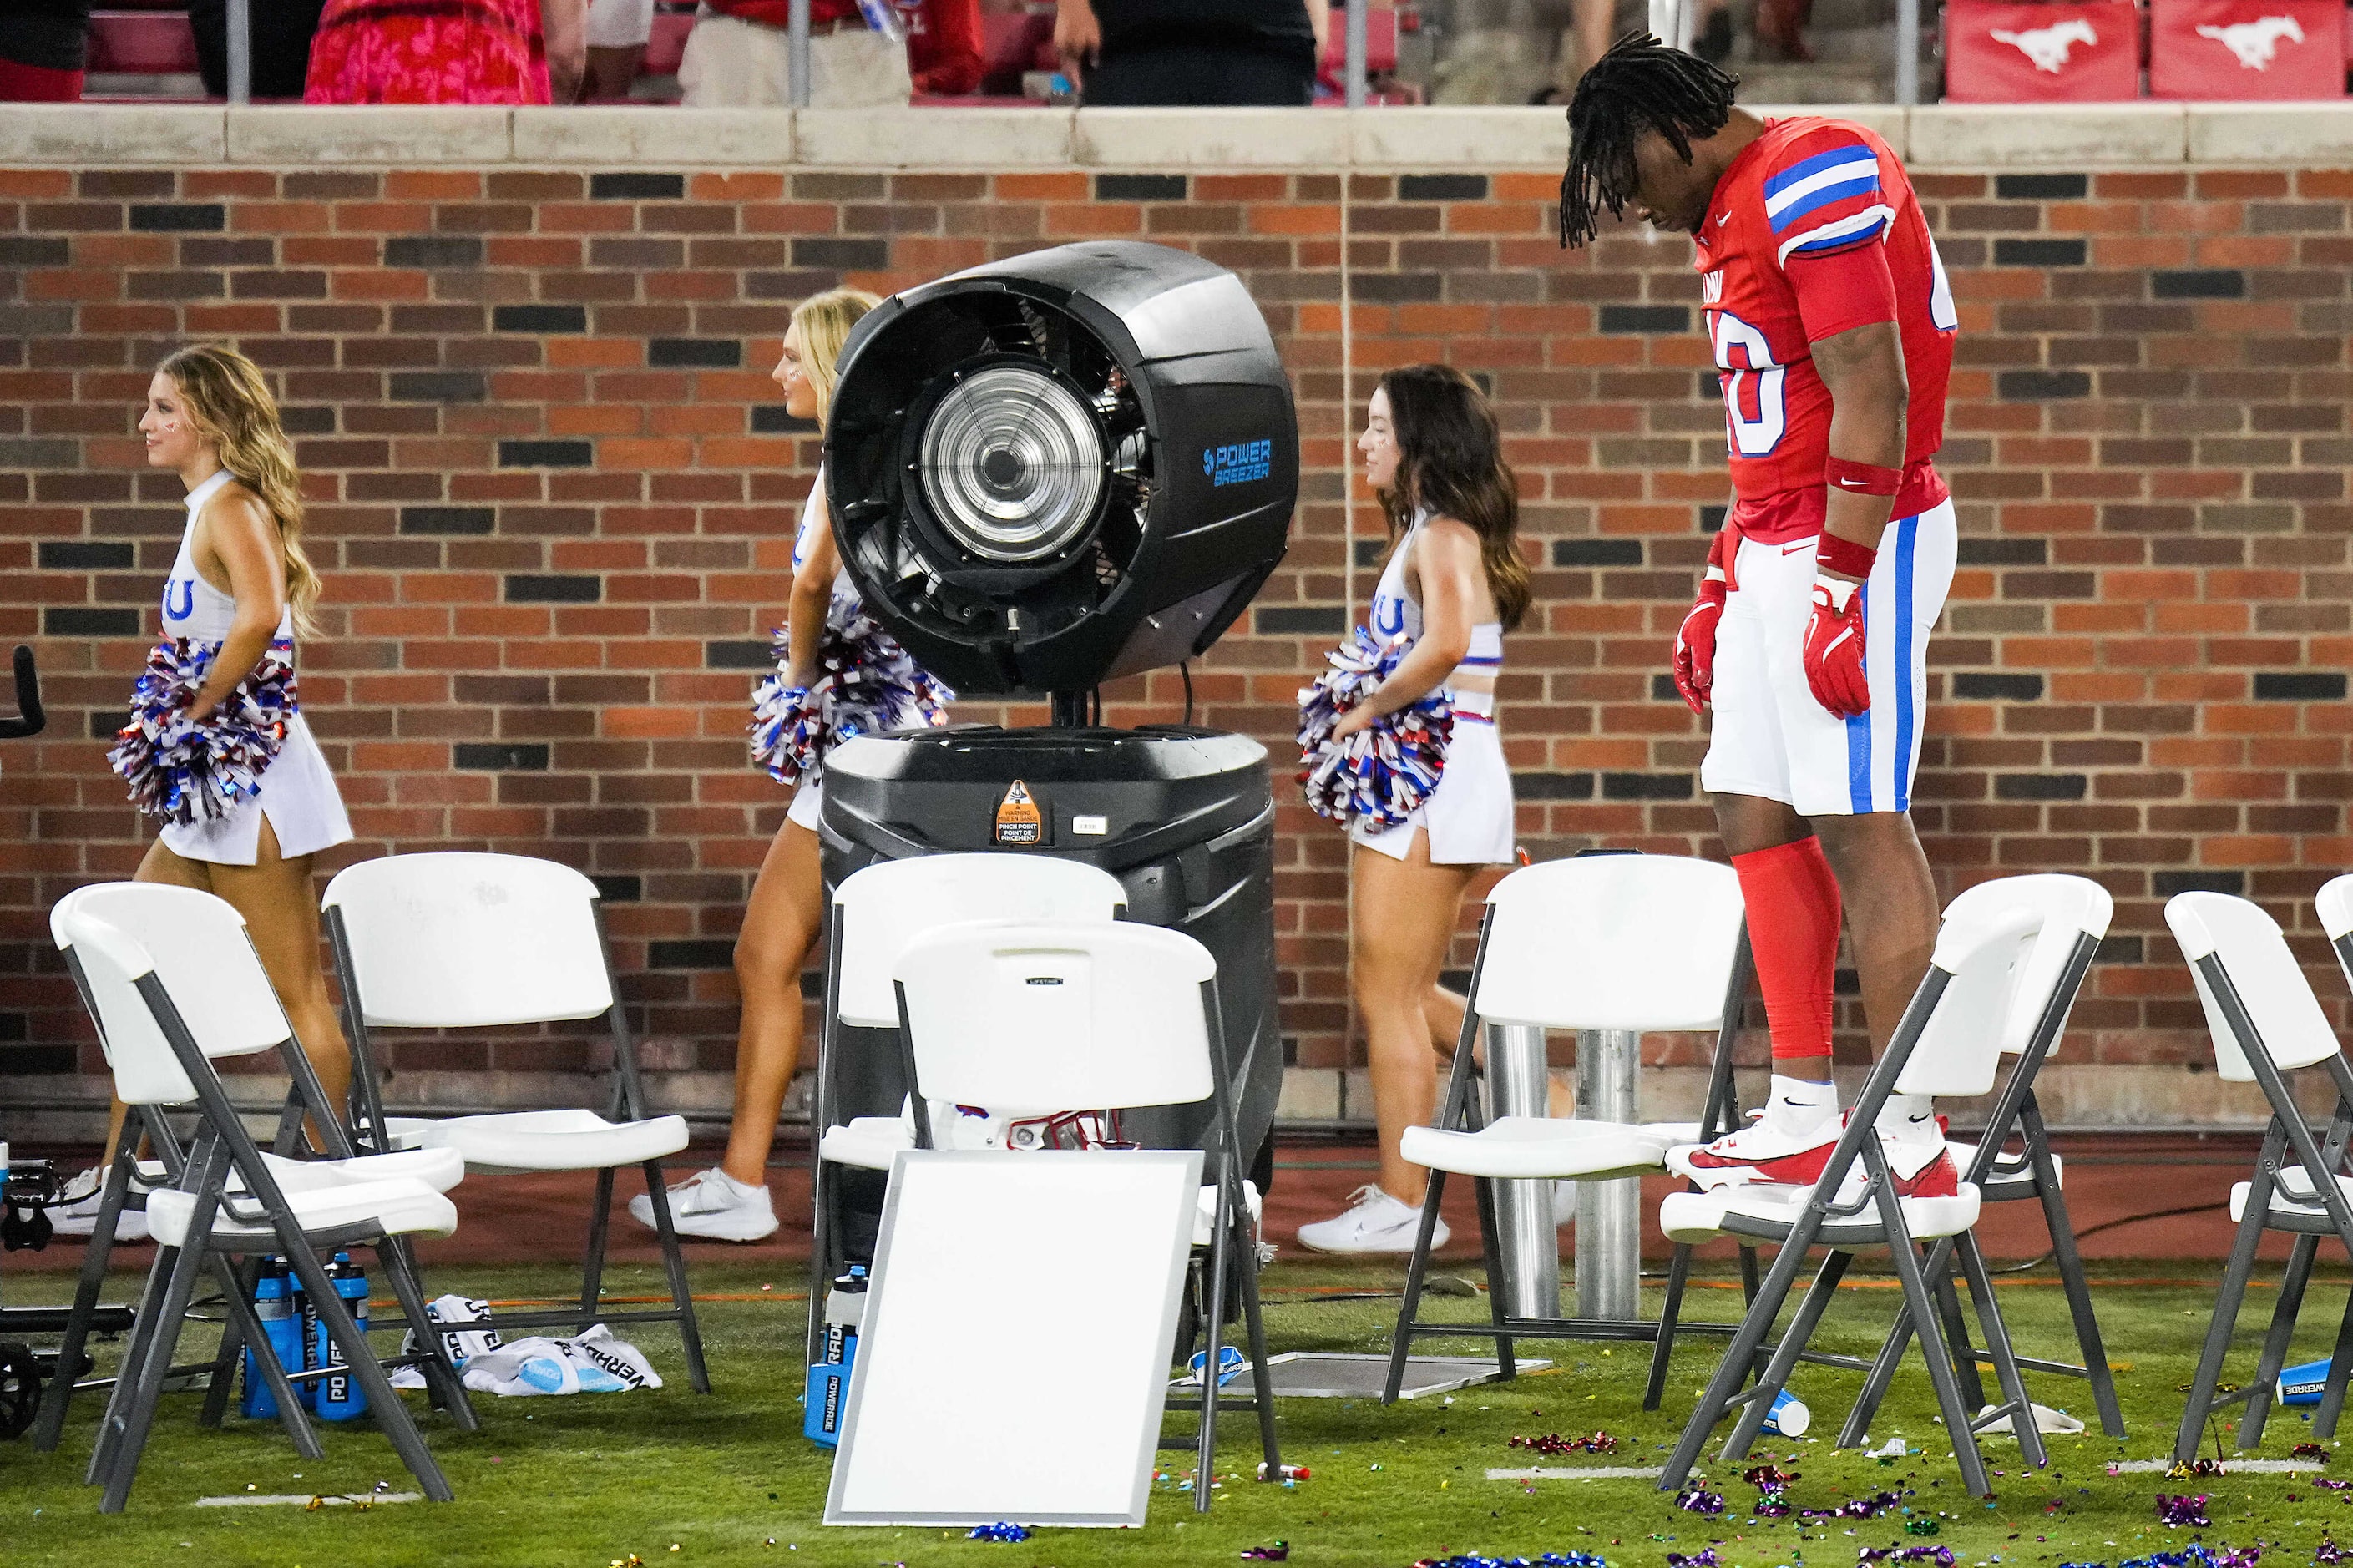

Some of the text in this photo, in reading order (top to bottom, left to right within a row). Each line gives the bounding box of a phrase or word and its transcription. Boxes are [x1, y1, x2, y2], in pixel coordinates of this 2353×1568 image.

[1707, 309, 1786, 458] 0
[1214, 462, 1269, 487] BREEZER
[1216, 439, 1270, 469] POWER
[161, 579, 194, 621] U
[1374, 594, 1404, 635] U
[824, 1376, 838, 1432] POWERADE
[2286, 1383, 2325, 1395] WERADE
